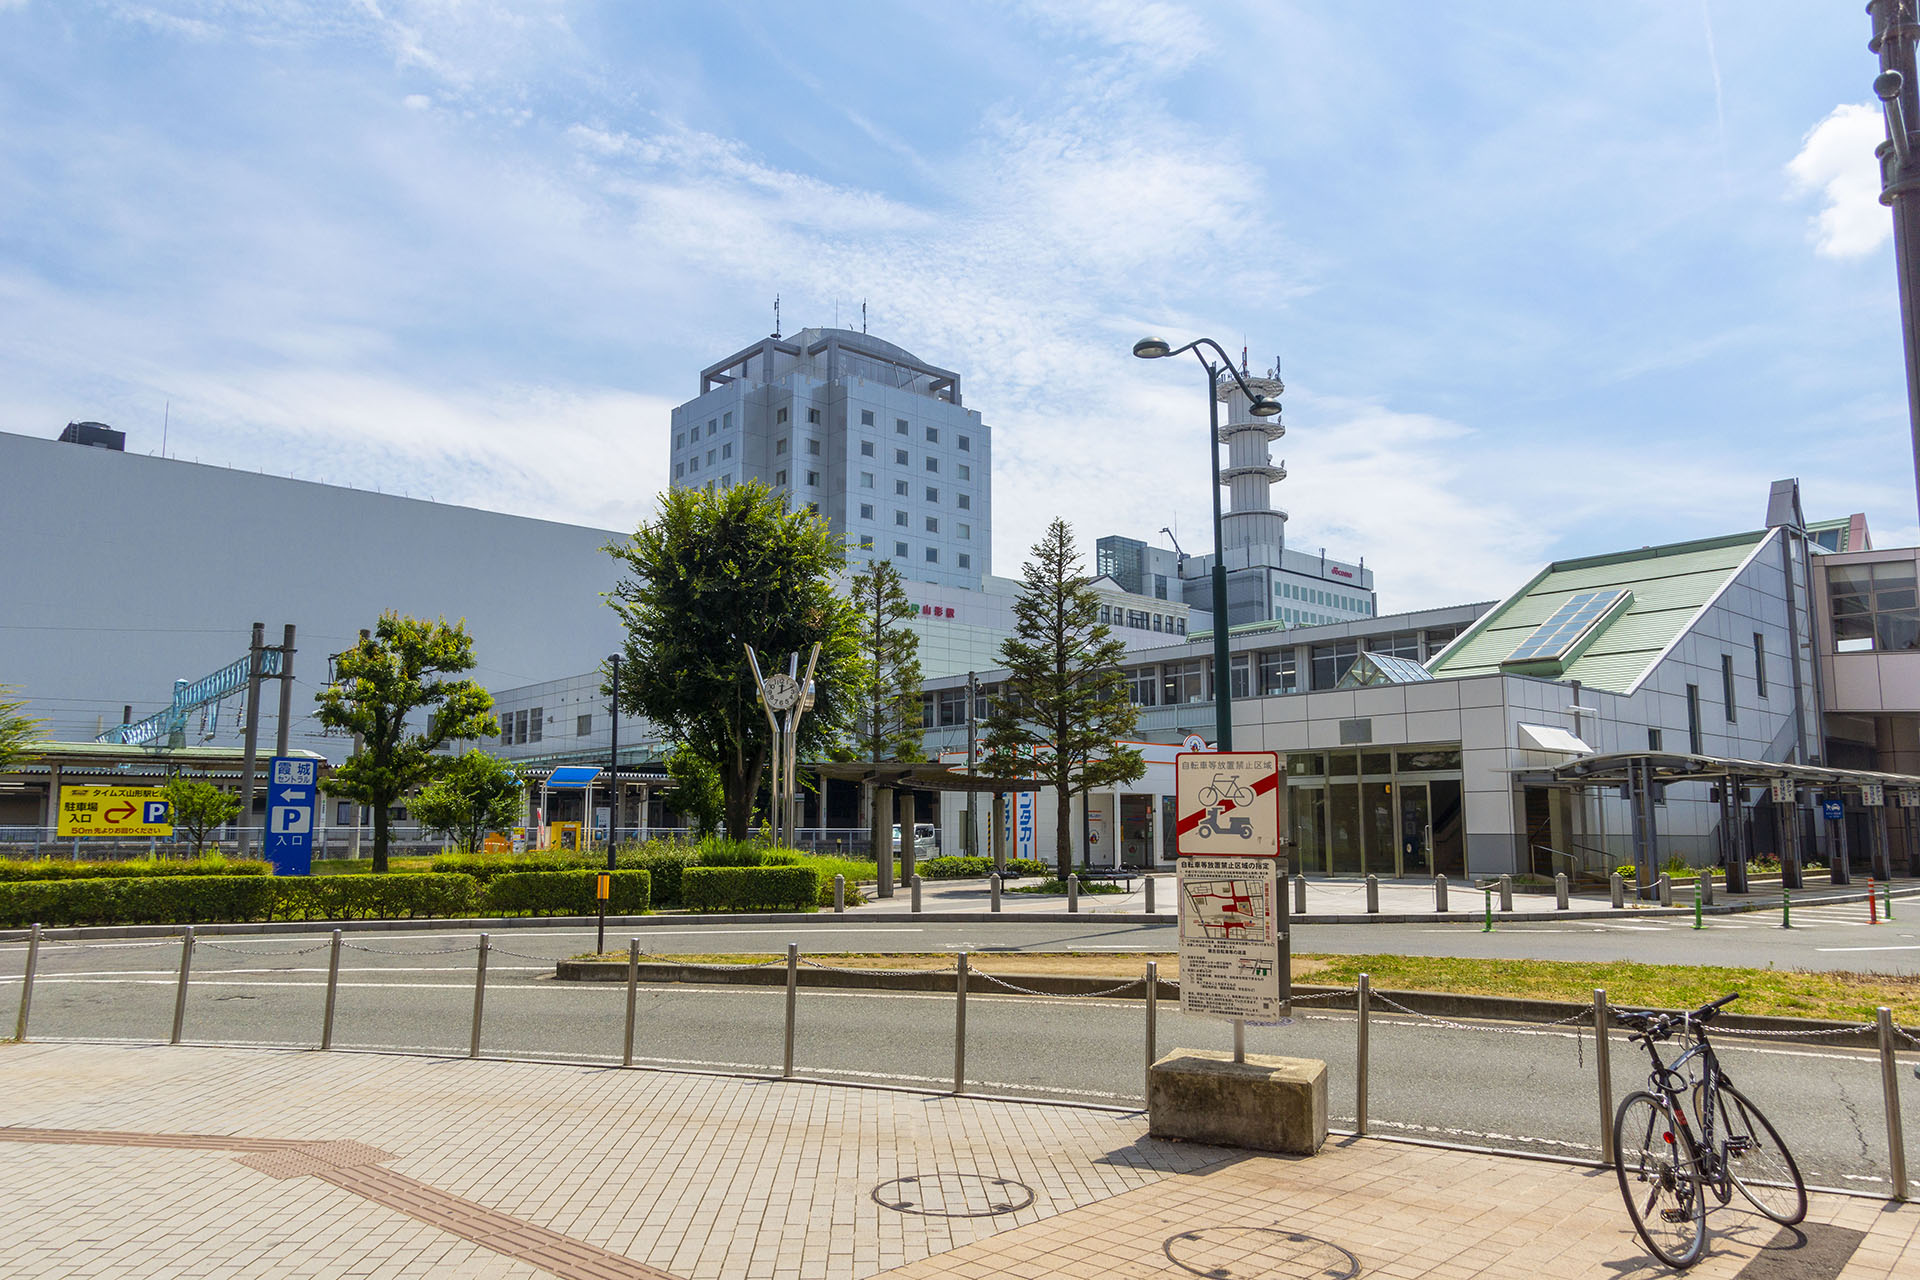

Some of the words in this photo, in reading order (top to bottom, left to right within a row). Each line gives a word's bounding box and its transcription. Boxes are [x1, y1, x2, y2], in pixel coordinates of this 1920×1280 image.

[1182, 760, 1272, 770] 自転車等放置禁止区域
[93, 789, 163, 798] タイムズ山形駅ビ
[64, 802, 98, 812] 駐車場
[69, 814, 92, 823] 入口
[276, 835, 303, 846] 入口
